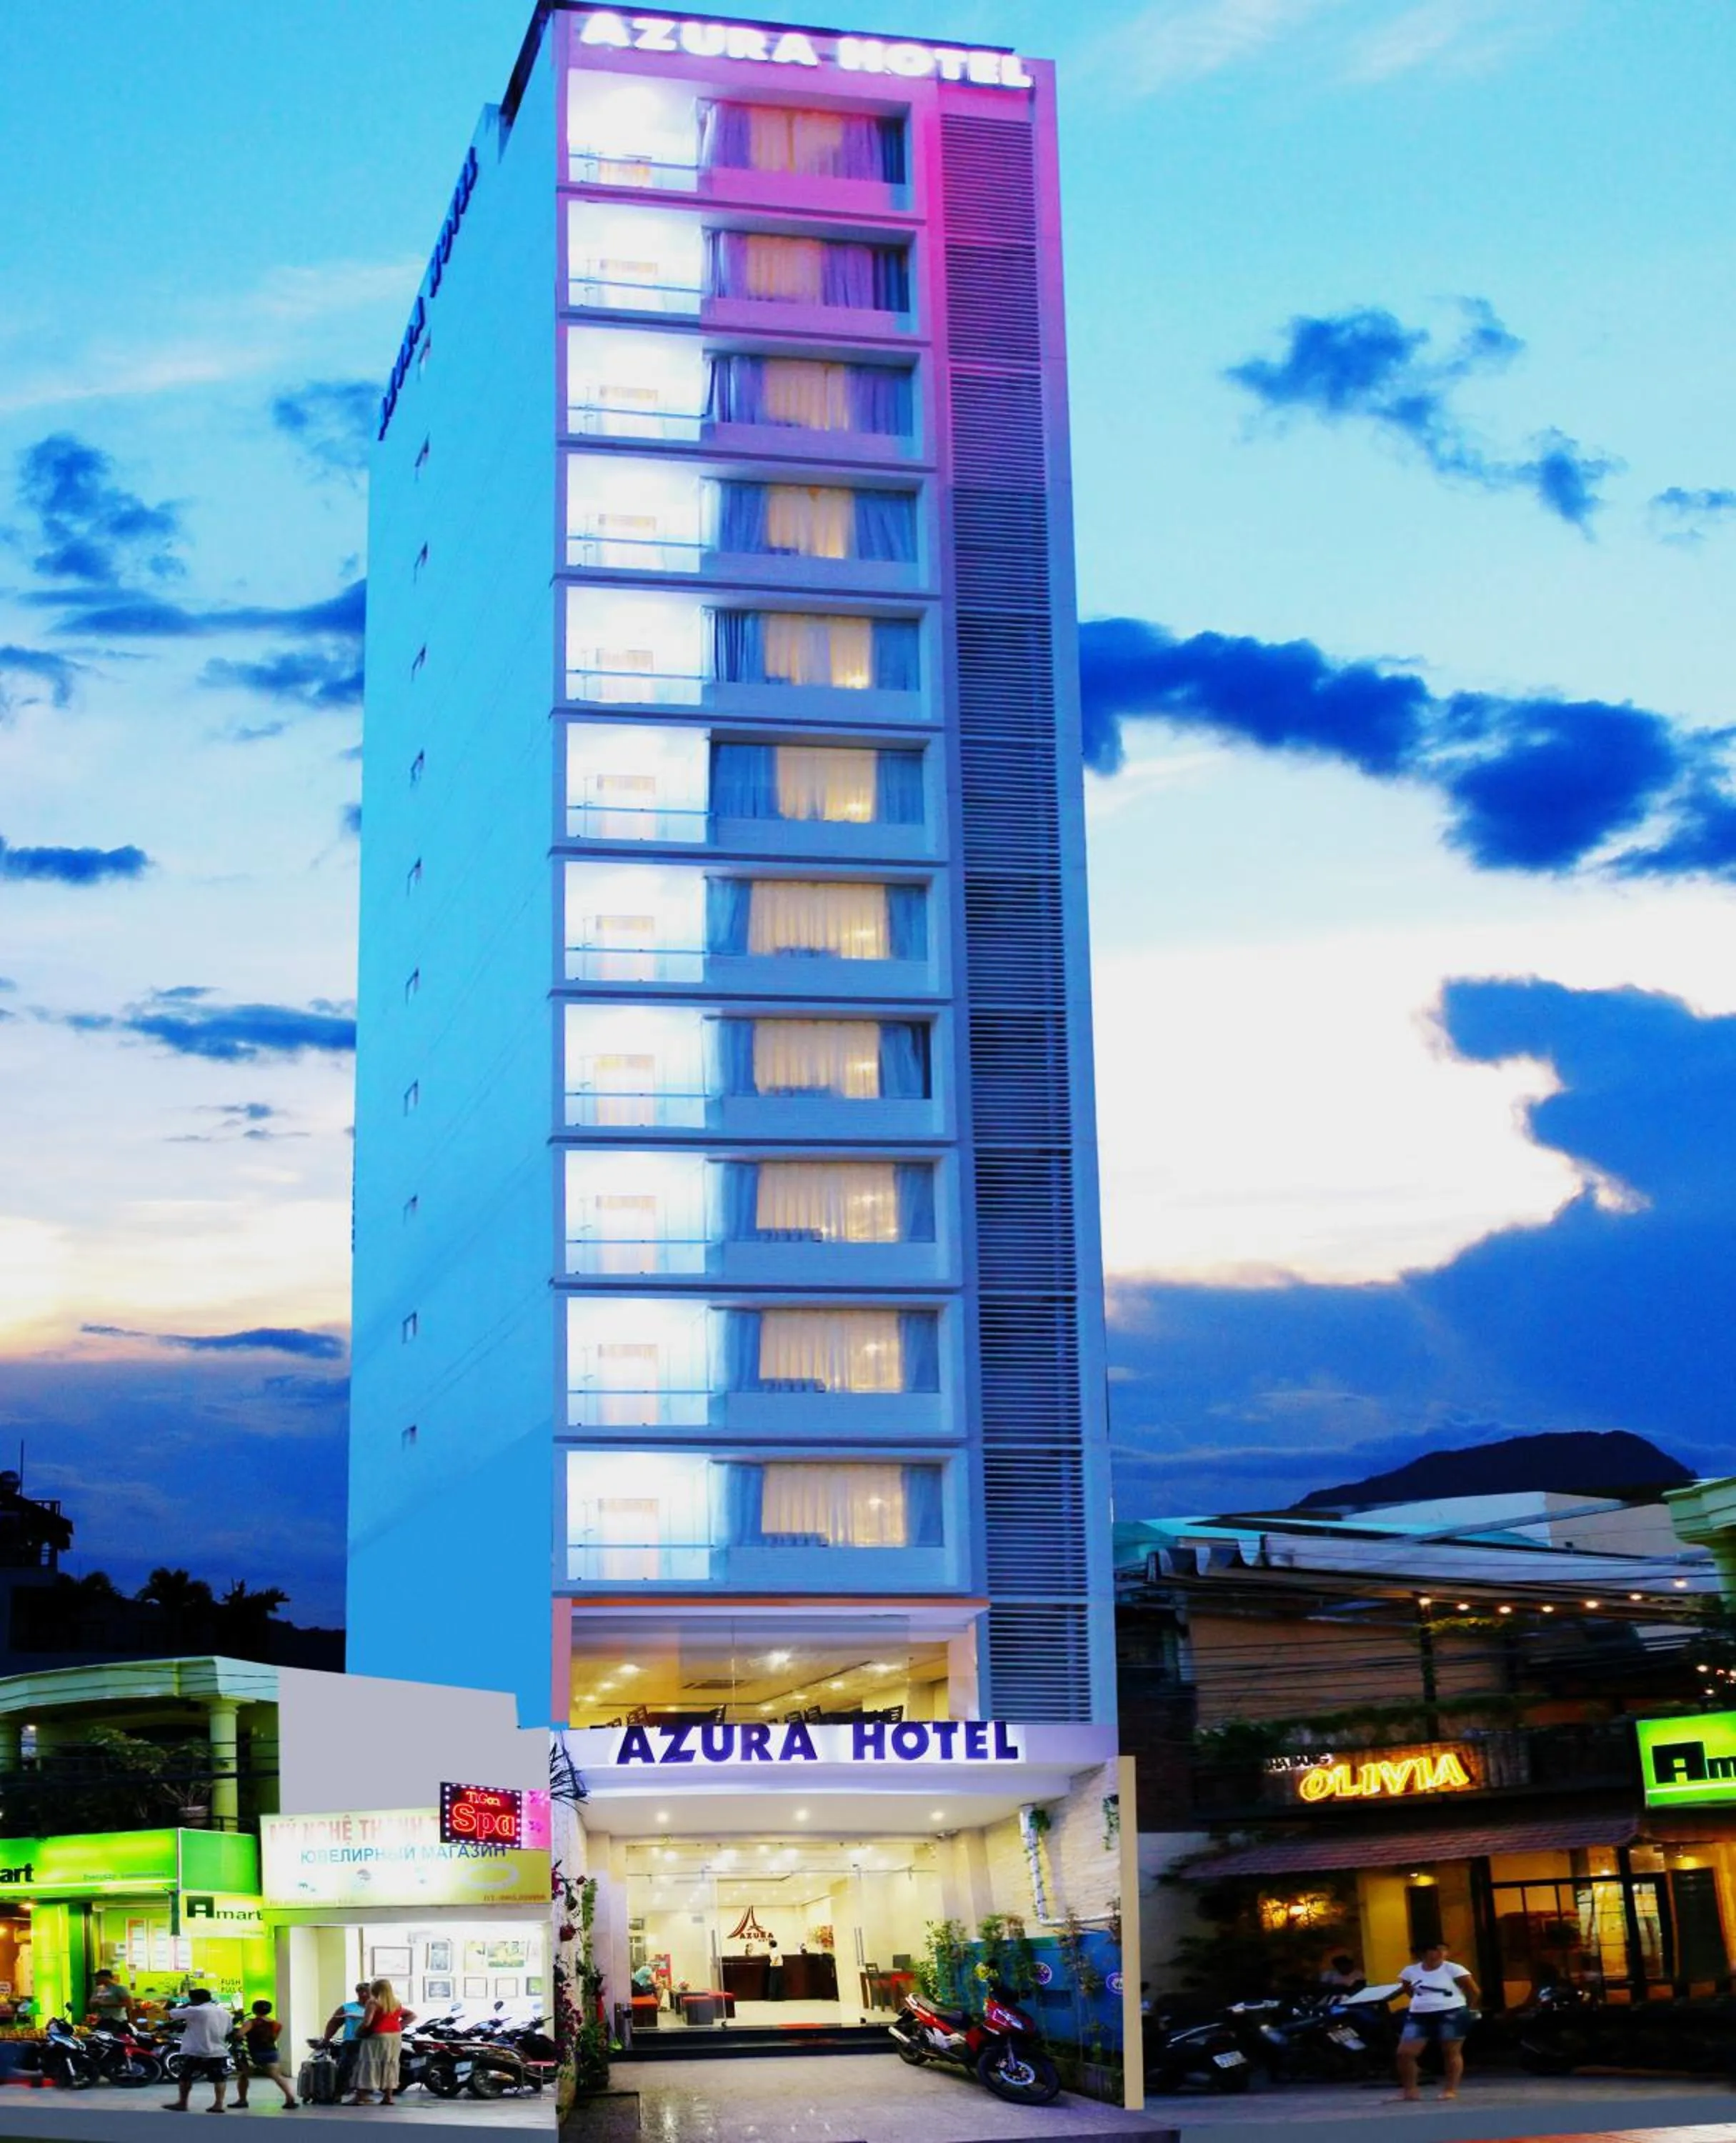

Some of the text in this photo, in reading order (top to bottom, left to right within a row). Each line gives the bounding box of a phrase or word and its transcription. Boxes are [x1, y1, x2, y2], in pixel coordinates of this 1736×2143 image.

[580, 12, 1034, 88] AZURA HOTEL
[616, 1719, 1019, 1765] AZURA HOTEL
[1299, 1752, 1470, 1801] OLIVIA
[452, 1803, 515, 1839] Spa
[423, 1844, 507, 1862] МАГАЗИН
